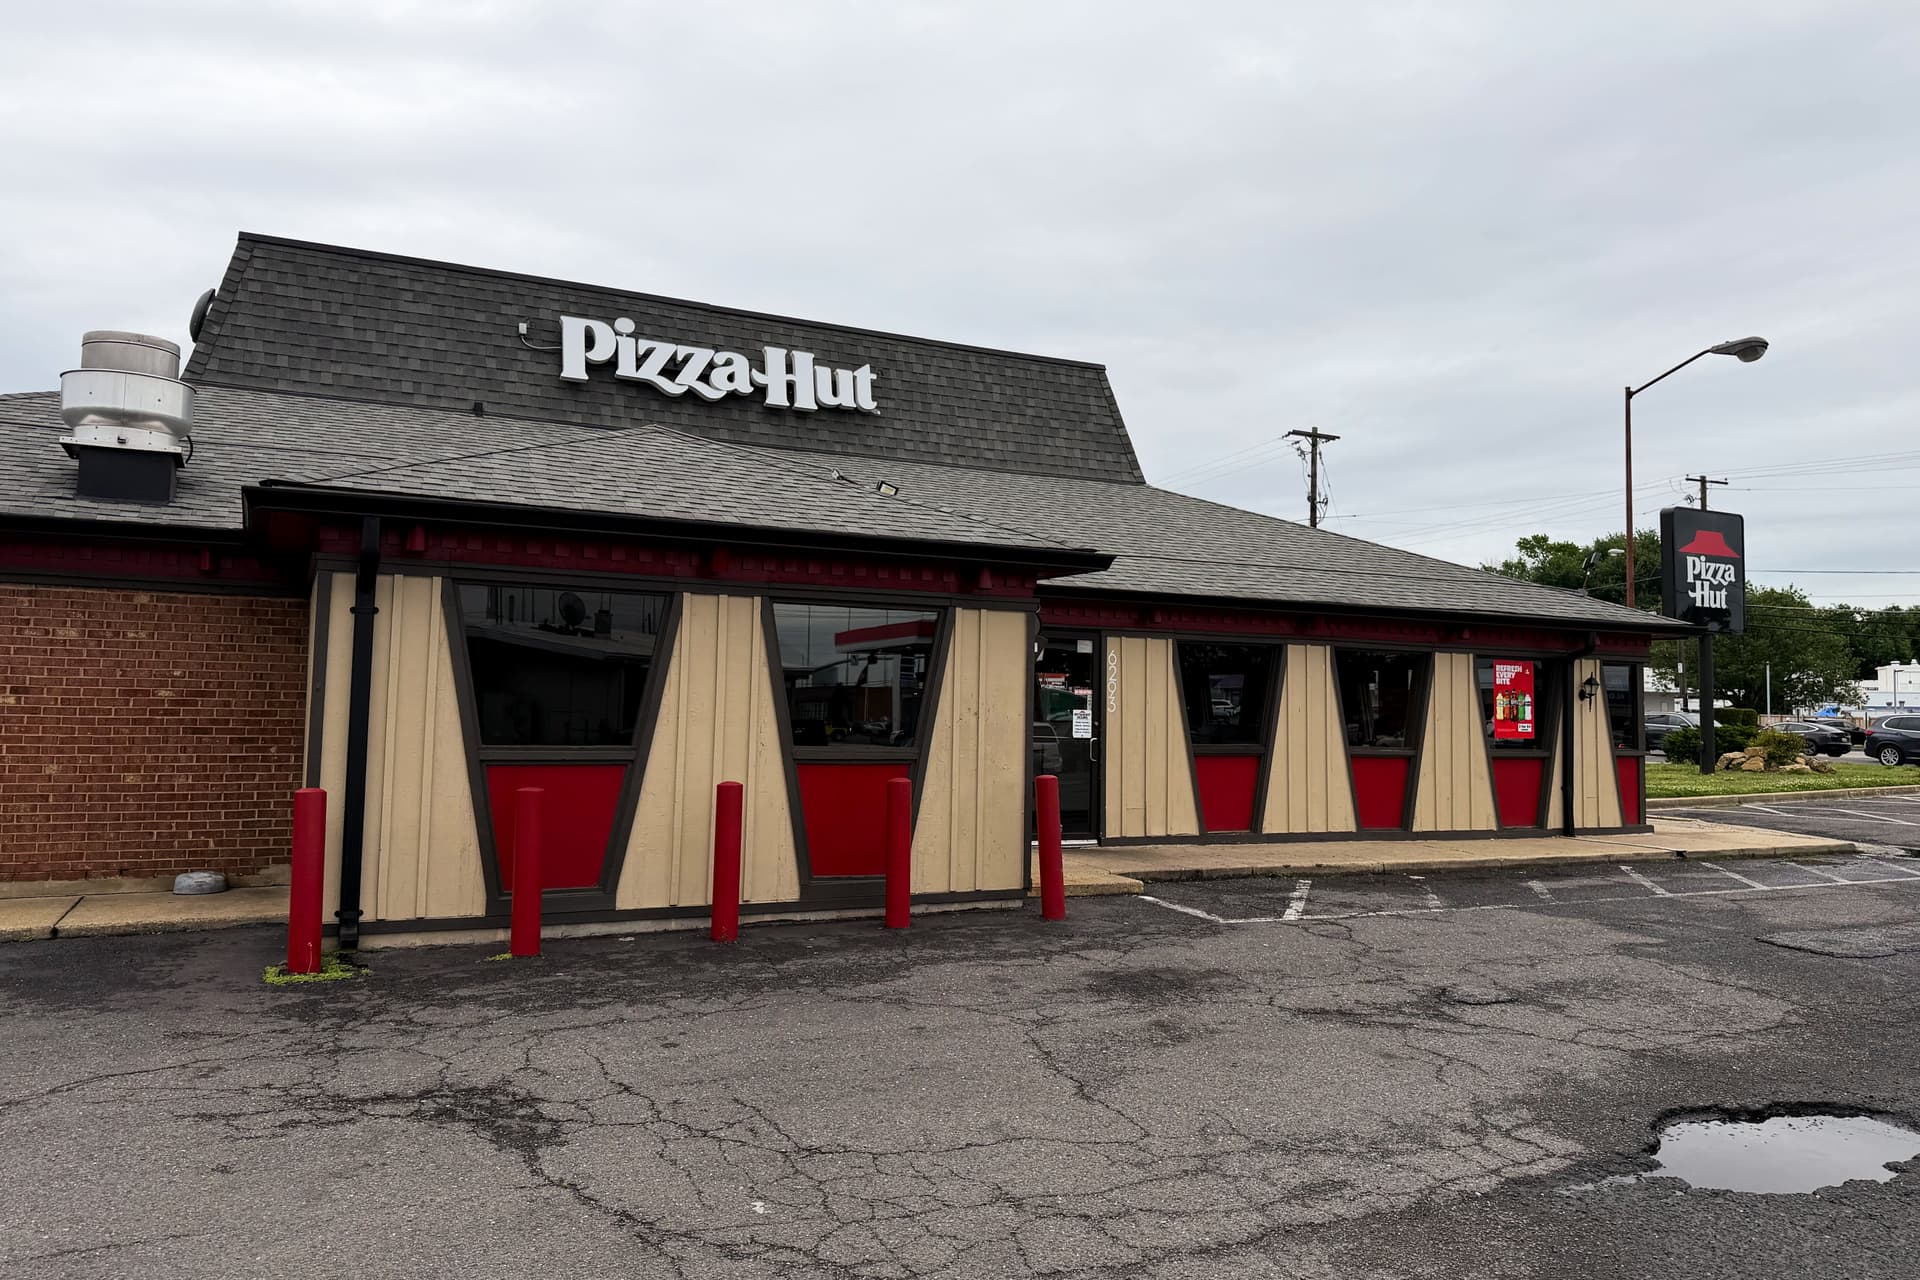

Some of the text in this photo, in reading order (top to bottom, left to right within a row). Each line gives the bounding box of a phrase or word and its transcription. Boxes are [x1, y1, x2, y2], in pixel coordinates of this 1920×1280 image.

[560, 316, 878, 412] Pizza Hut
[1686, 555, 1736, 586] Pizza
[1688, 580, 1728, 609] Hut
[1107, 650, 1117, 713] 6293
[1496, 664, 1523, 673] REFRESH
[1496, 671, 1516, 679] EVERY
